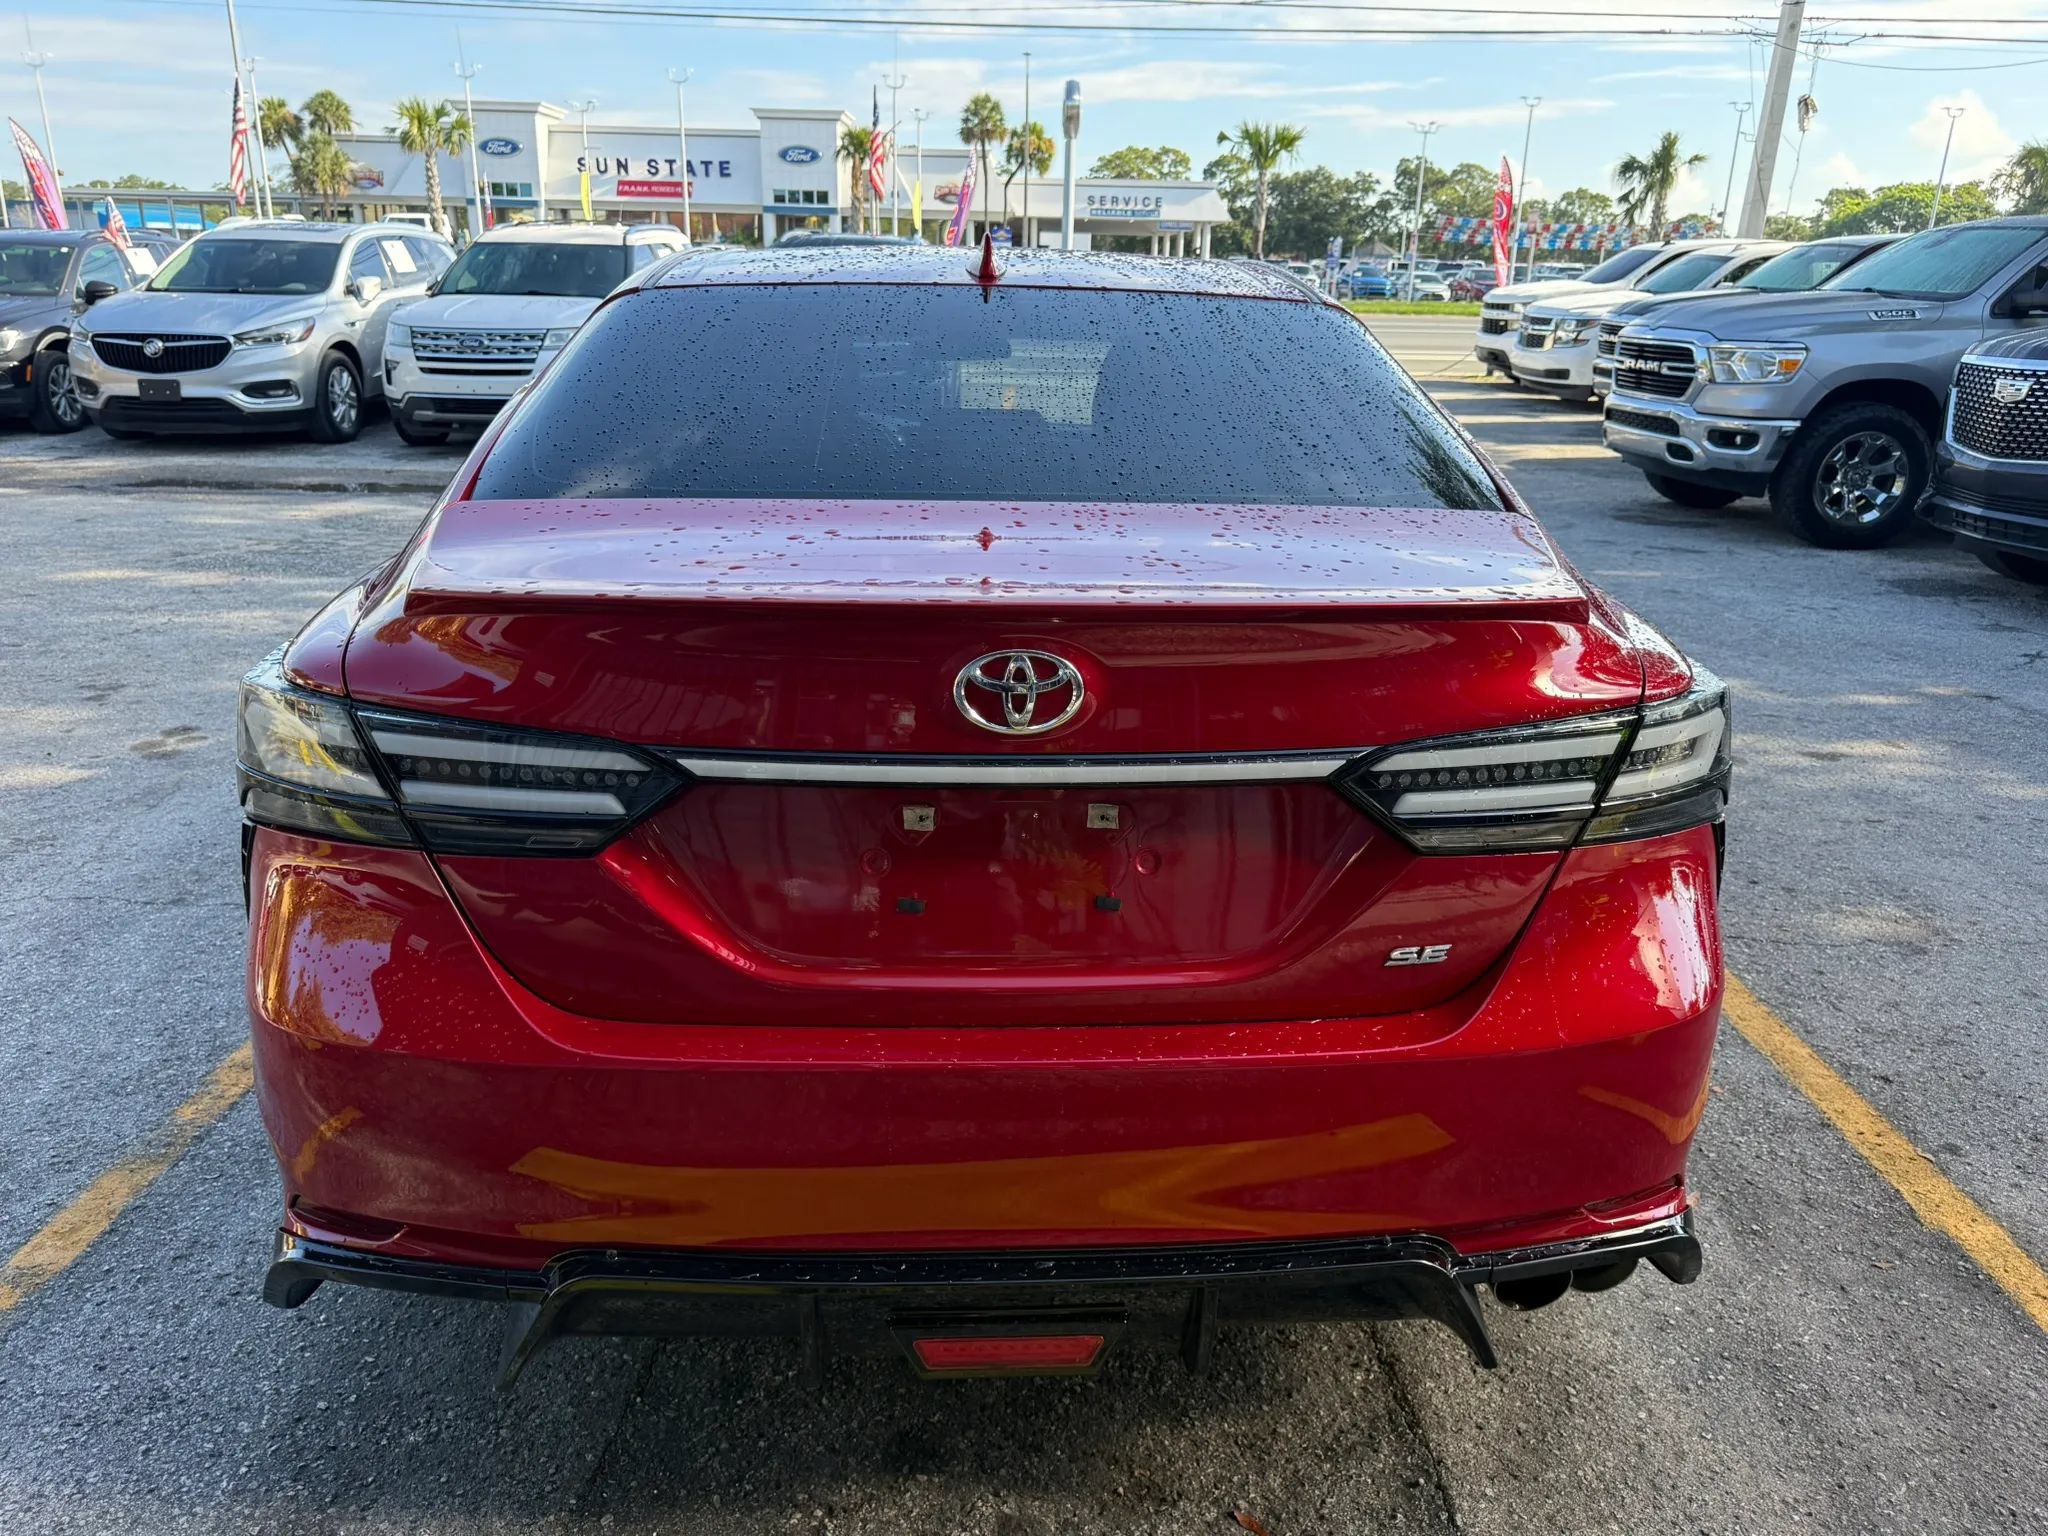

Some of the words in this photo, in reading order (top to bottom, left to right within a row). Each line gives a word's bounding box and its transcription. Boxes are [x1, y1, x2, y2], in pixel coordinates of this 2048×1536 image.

[577, 157, 629, 175] SUN
[647, 159, 732, 178] STATE
[1087, 195, 1163, 208] SERVICE
[1624, 359, 1661, 373] RAM
[1384, 944, 1453, 967] SE
